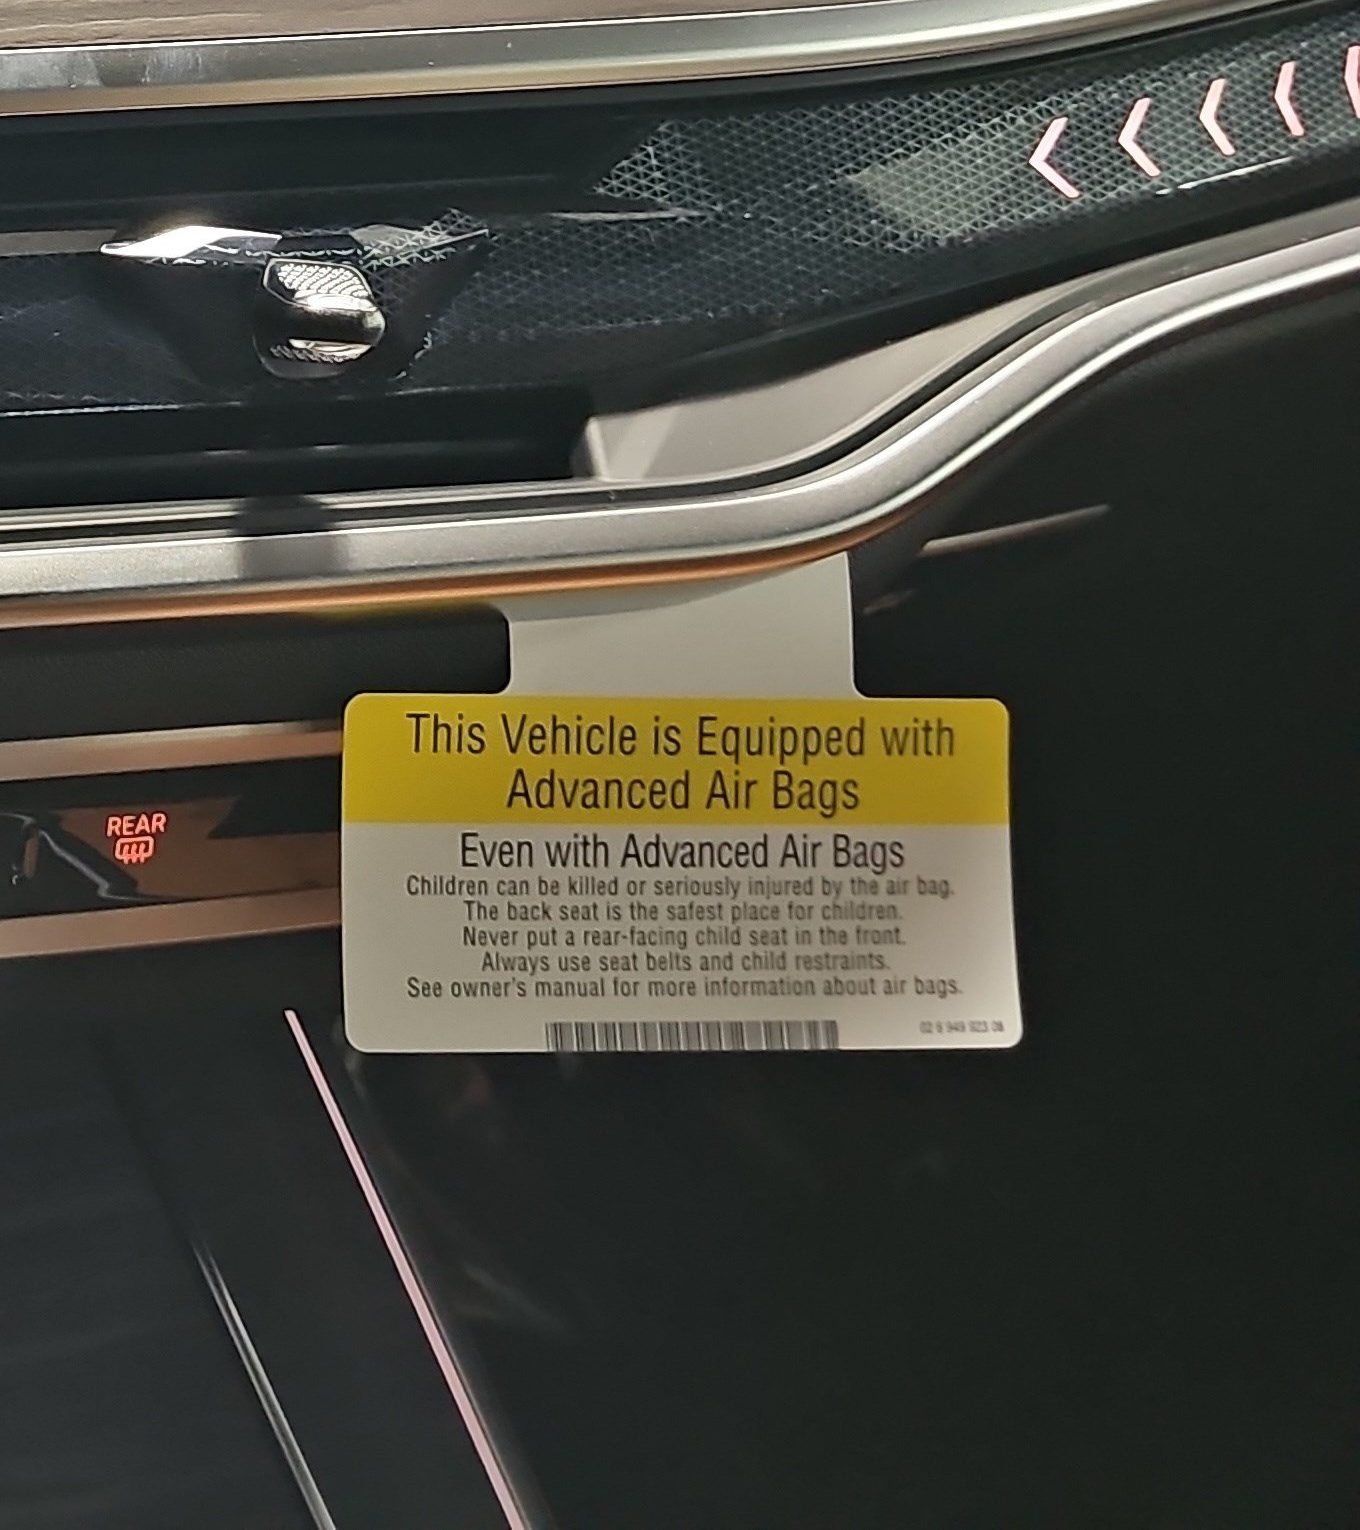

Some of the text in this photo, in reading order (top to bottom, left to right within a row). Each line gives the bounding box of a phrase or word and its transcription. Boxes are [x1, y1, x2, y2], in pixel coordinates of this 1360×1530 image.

[406, 713, 955, 765] This Vehicle is Equipped with
[507, 768, 860, 818] Advanced Air Bags
[106, 811, 166, 837] REAR
[460, 832, 905, 875] Even with Advanced Air Bags
[406, 874, 955, 900] Children can be killed or seriously injured by the air bag.
[463, 900, 903, 925] The back seat is the safest place for children.
[463, 926, 906, 950] Never put a rear-facing child seat in the front.
[481, 950, 891, 976] Always use seat belts and child restraints.
[407, 976, 963, 999] See owner's manual for more information about air bags.
